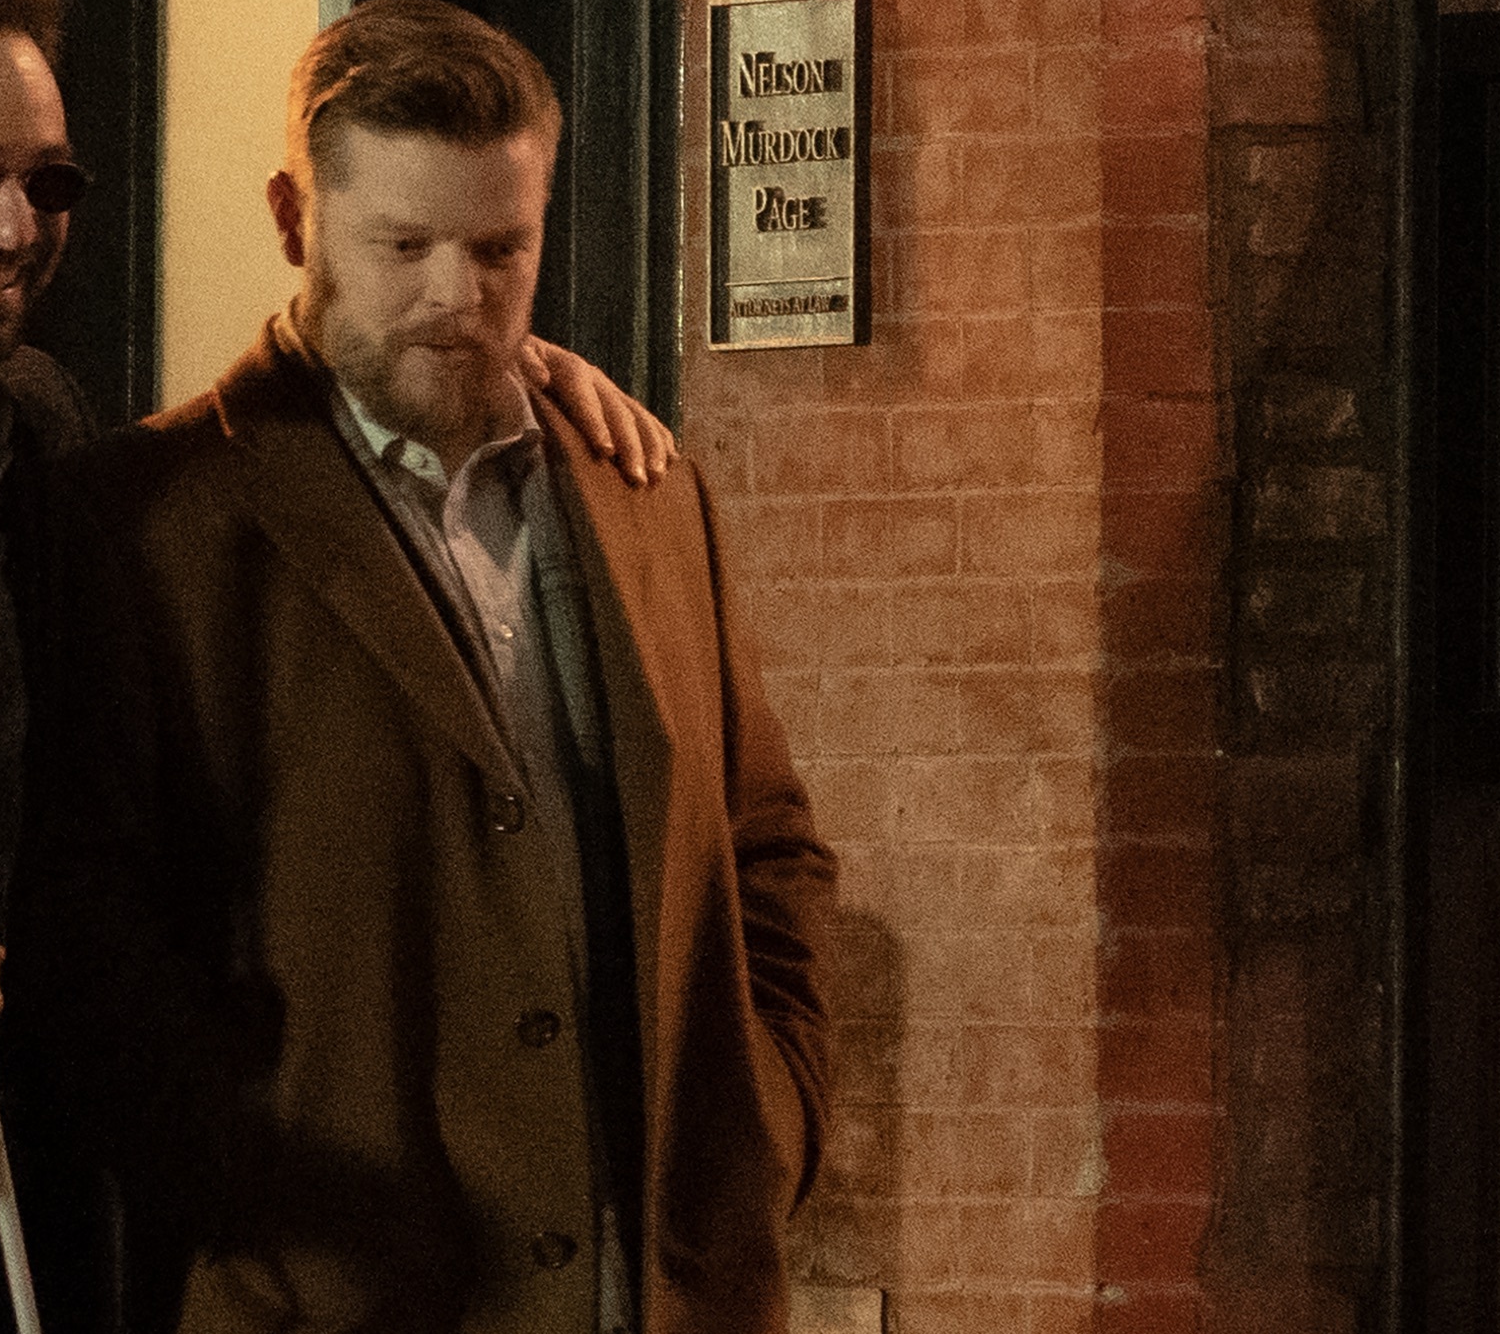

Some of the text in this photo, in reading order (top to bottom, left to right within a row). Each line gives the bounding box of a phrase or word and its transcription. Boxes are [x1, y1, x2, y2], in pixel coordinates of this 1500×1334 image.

[738, 53, 826, 97] NELSON
[721, 120, 840, 167] MURDOCK
[752, 186, 811, 233] PAGE
